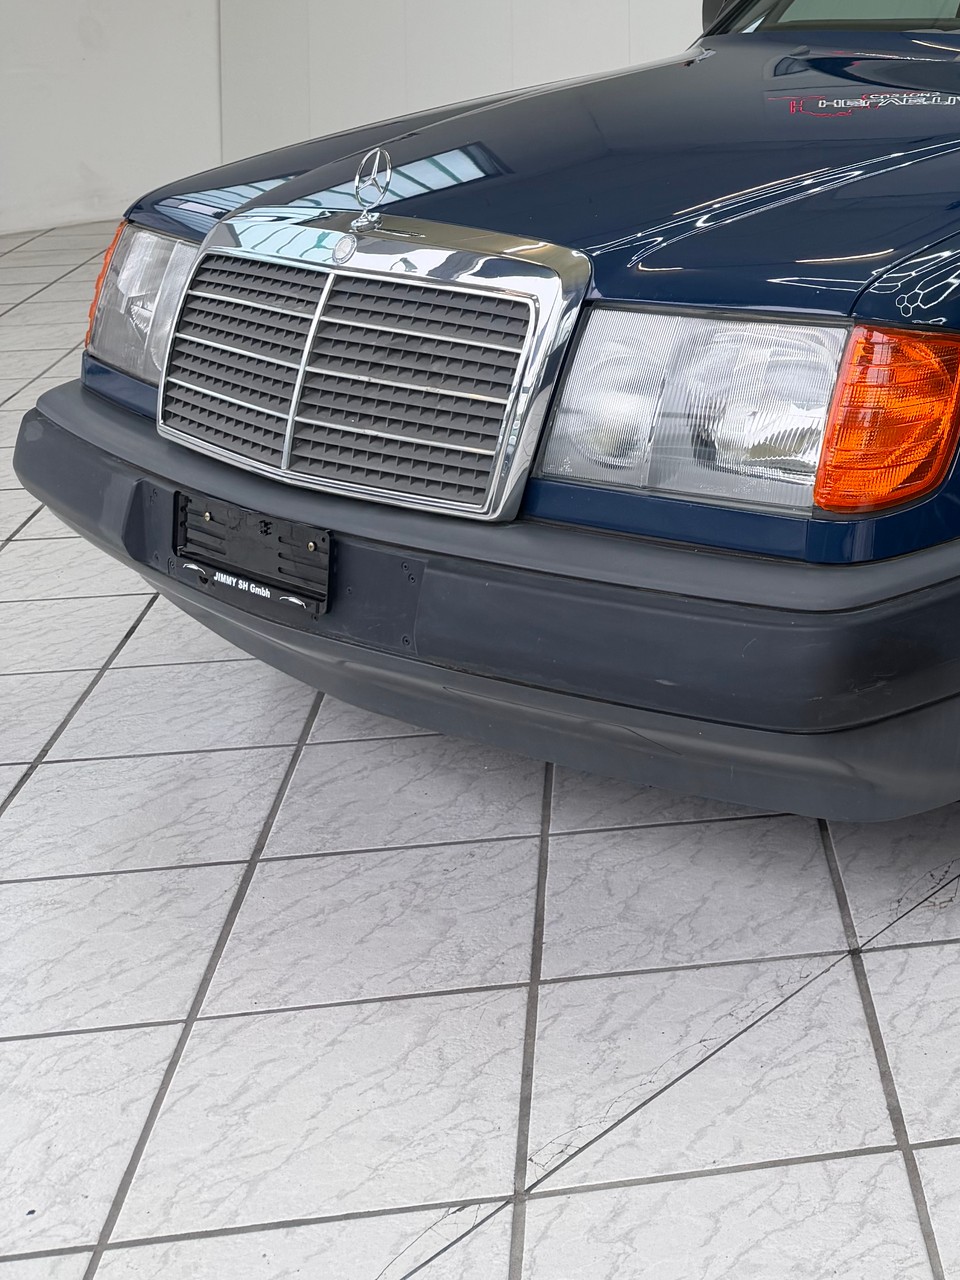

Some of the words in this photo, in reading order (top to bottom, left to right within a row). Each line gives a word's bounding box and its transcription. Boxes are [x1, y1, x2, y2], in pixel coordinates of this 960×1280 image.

[213, 571, 237, 586] JIMMY
[238, 579, 249, 591] SH
[249, 583, 271, 598] Gmbh
